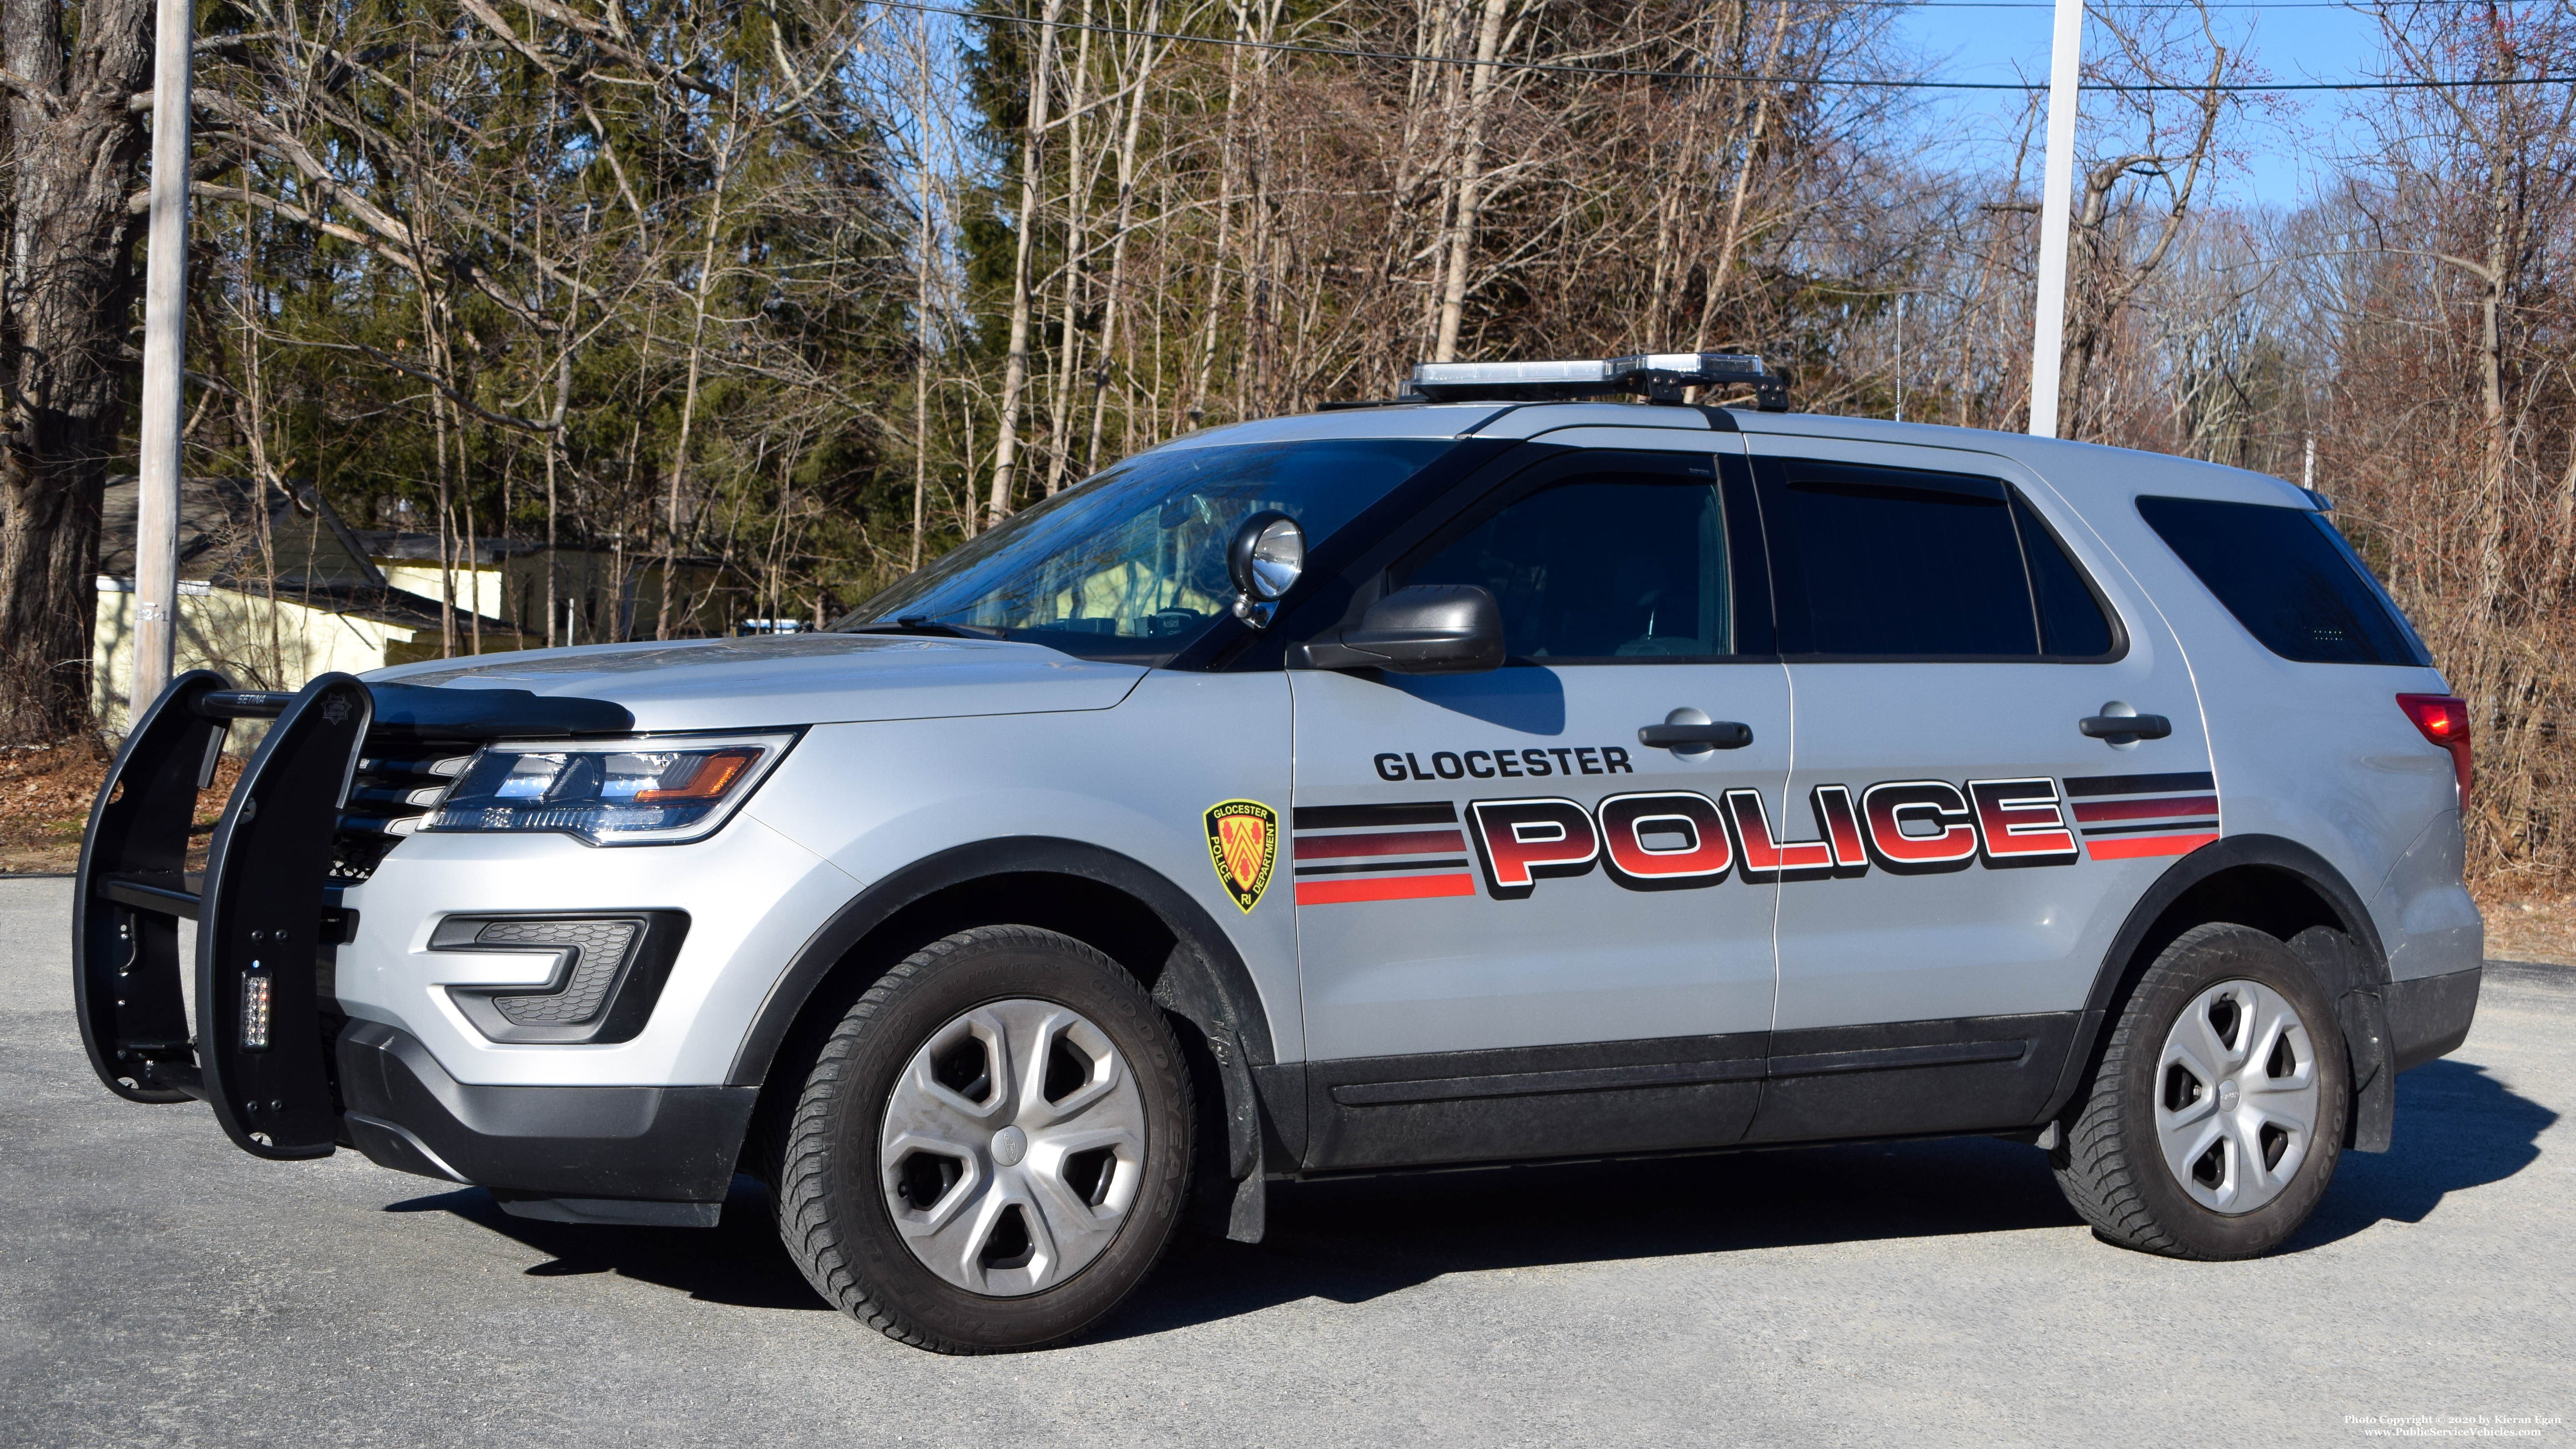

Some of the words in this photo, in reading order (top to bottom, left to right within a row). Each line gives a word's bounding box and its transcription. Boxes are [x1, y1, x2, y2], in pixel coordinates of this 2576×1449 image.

[237, 694, 266, 704] SETINA
[1373, 746, 1634, 781] GLOCESTER
[1214, 805, 1268, 820] GLOCESTER
[1465, 776, 2080, 901] POLICE
[1211, 836, 1233, 883] POLICE
[1252, 821, 1274, 895] DEPARTMENT
[1241, 894, 1251, 905] RI
[854, 1011, 913, 1113] GRIP
[1089, 977, 1184, 1220] GOODYEAR
[1004, 1132, 1017, 1158] Ford
[2246, 1084, 2344, 1244] GOODYEAR
[844, 1126, 886, 1264] ULTRA
[884, 1276, 1010, 1338] EAGLE
